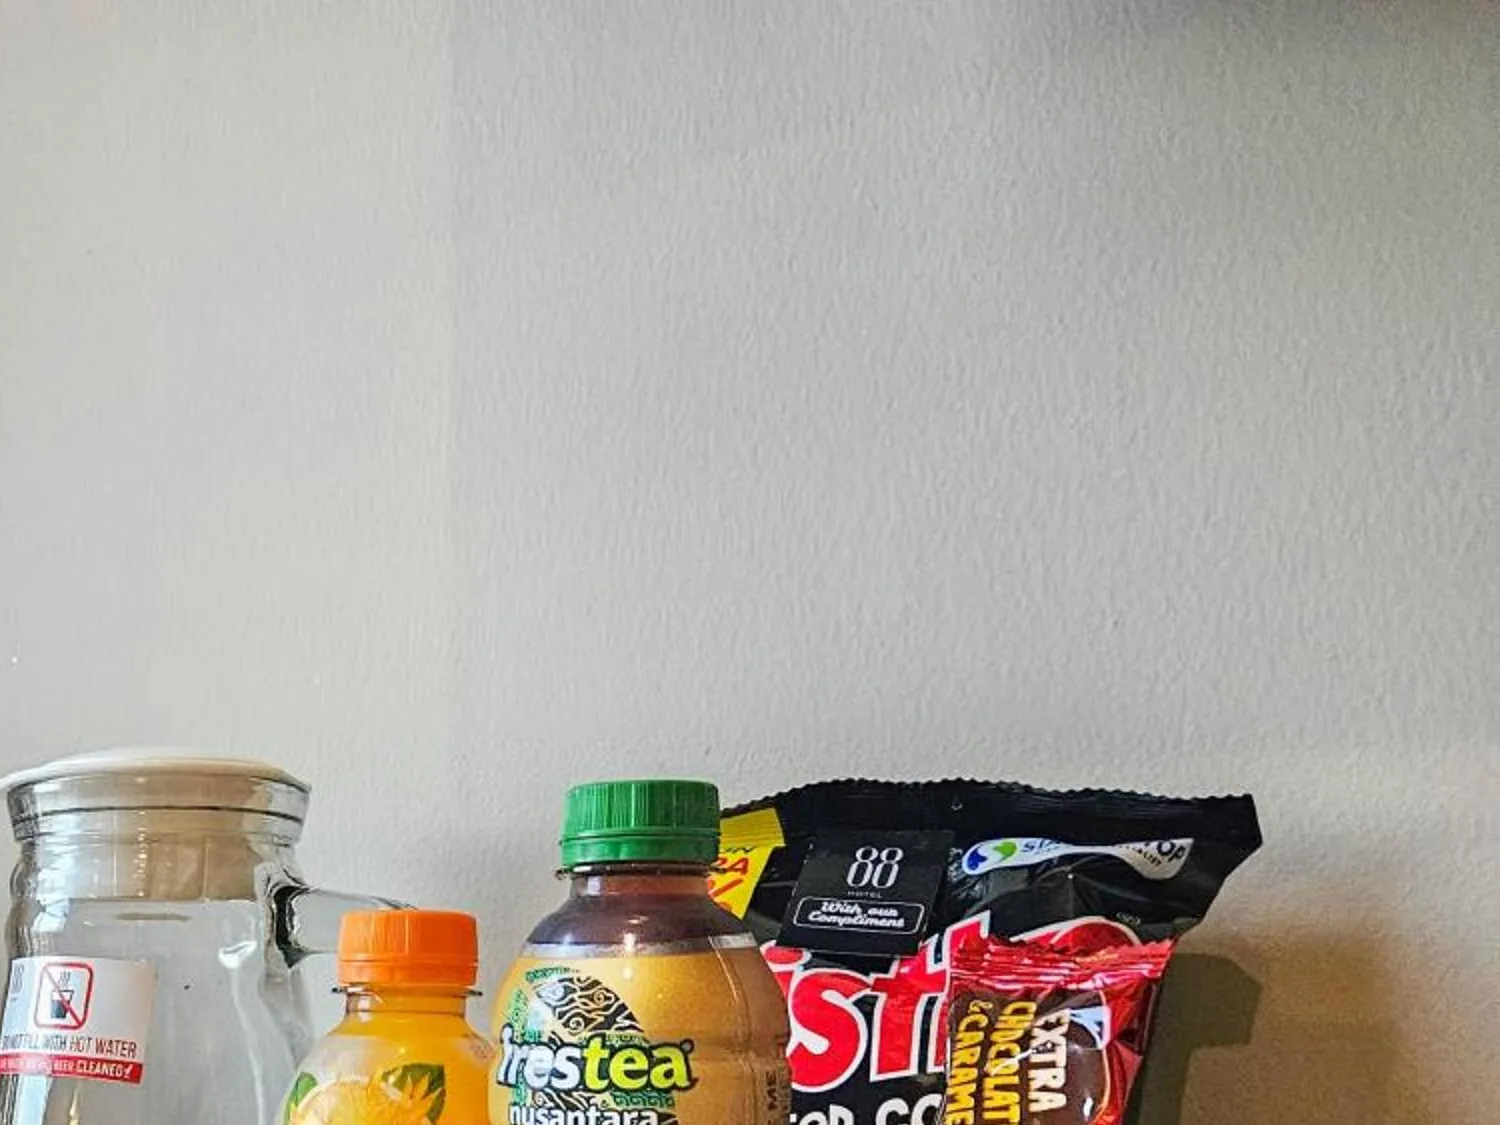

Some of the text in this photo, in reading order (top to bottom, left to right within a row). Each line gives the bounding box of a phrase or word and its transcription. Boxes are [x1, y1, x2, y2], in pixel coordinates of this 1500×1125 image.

[847, 846, 904, 888] 88
[808, 911, 906, 928] Compliment
[821, 901, 899, 917] With our
[69, 1036, 93, 1053] HOT
[95, 1038, 138, 1059] WATER
[1027, 1009, 1070, 1113] EXTRA
